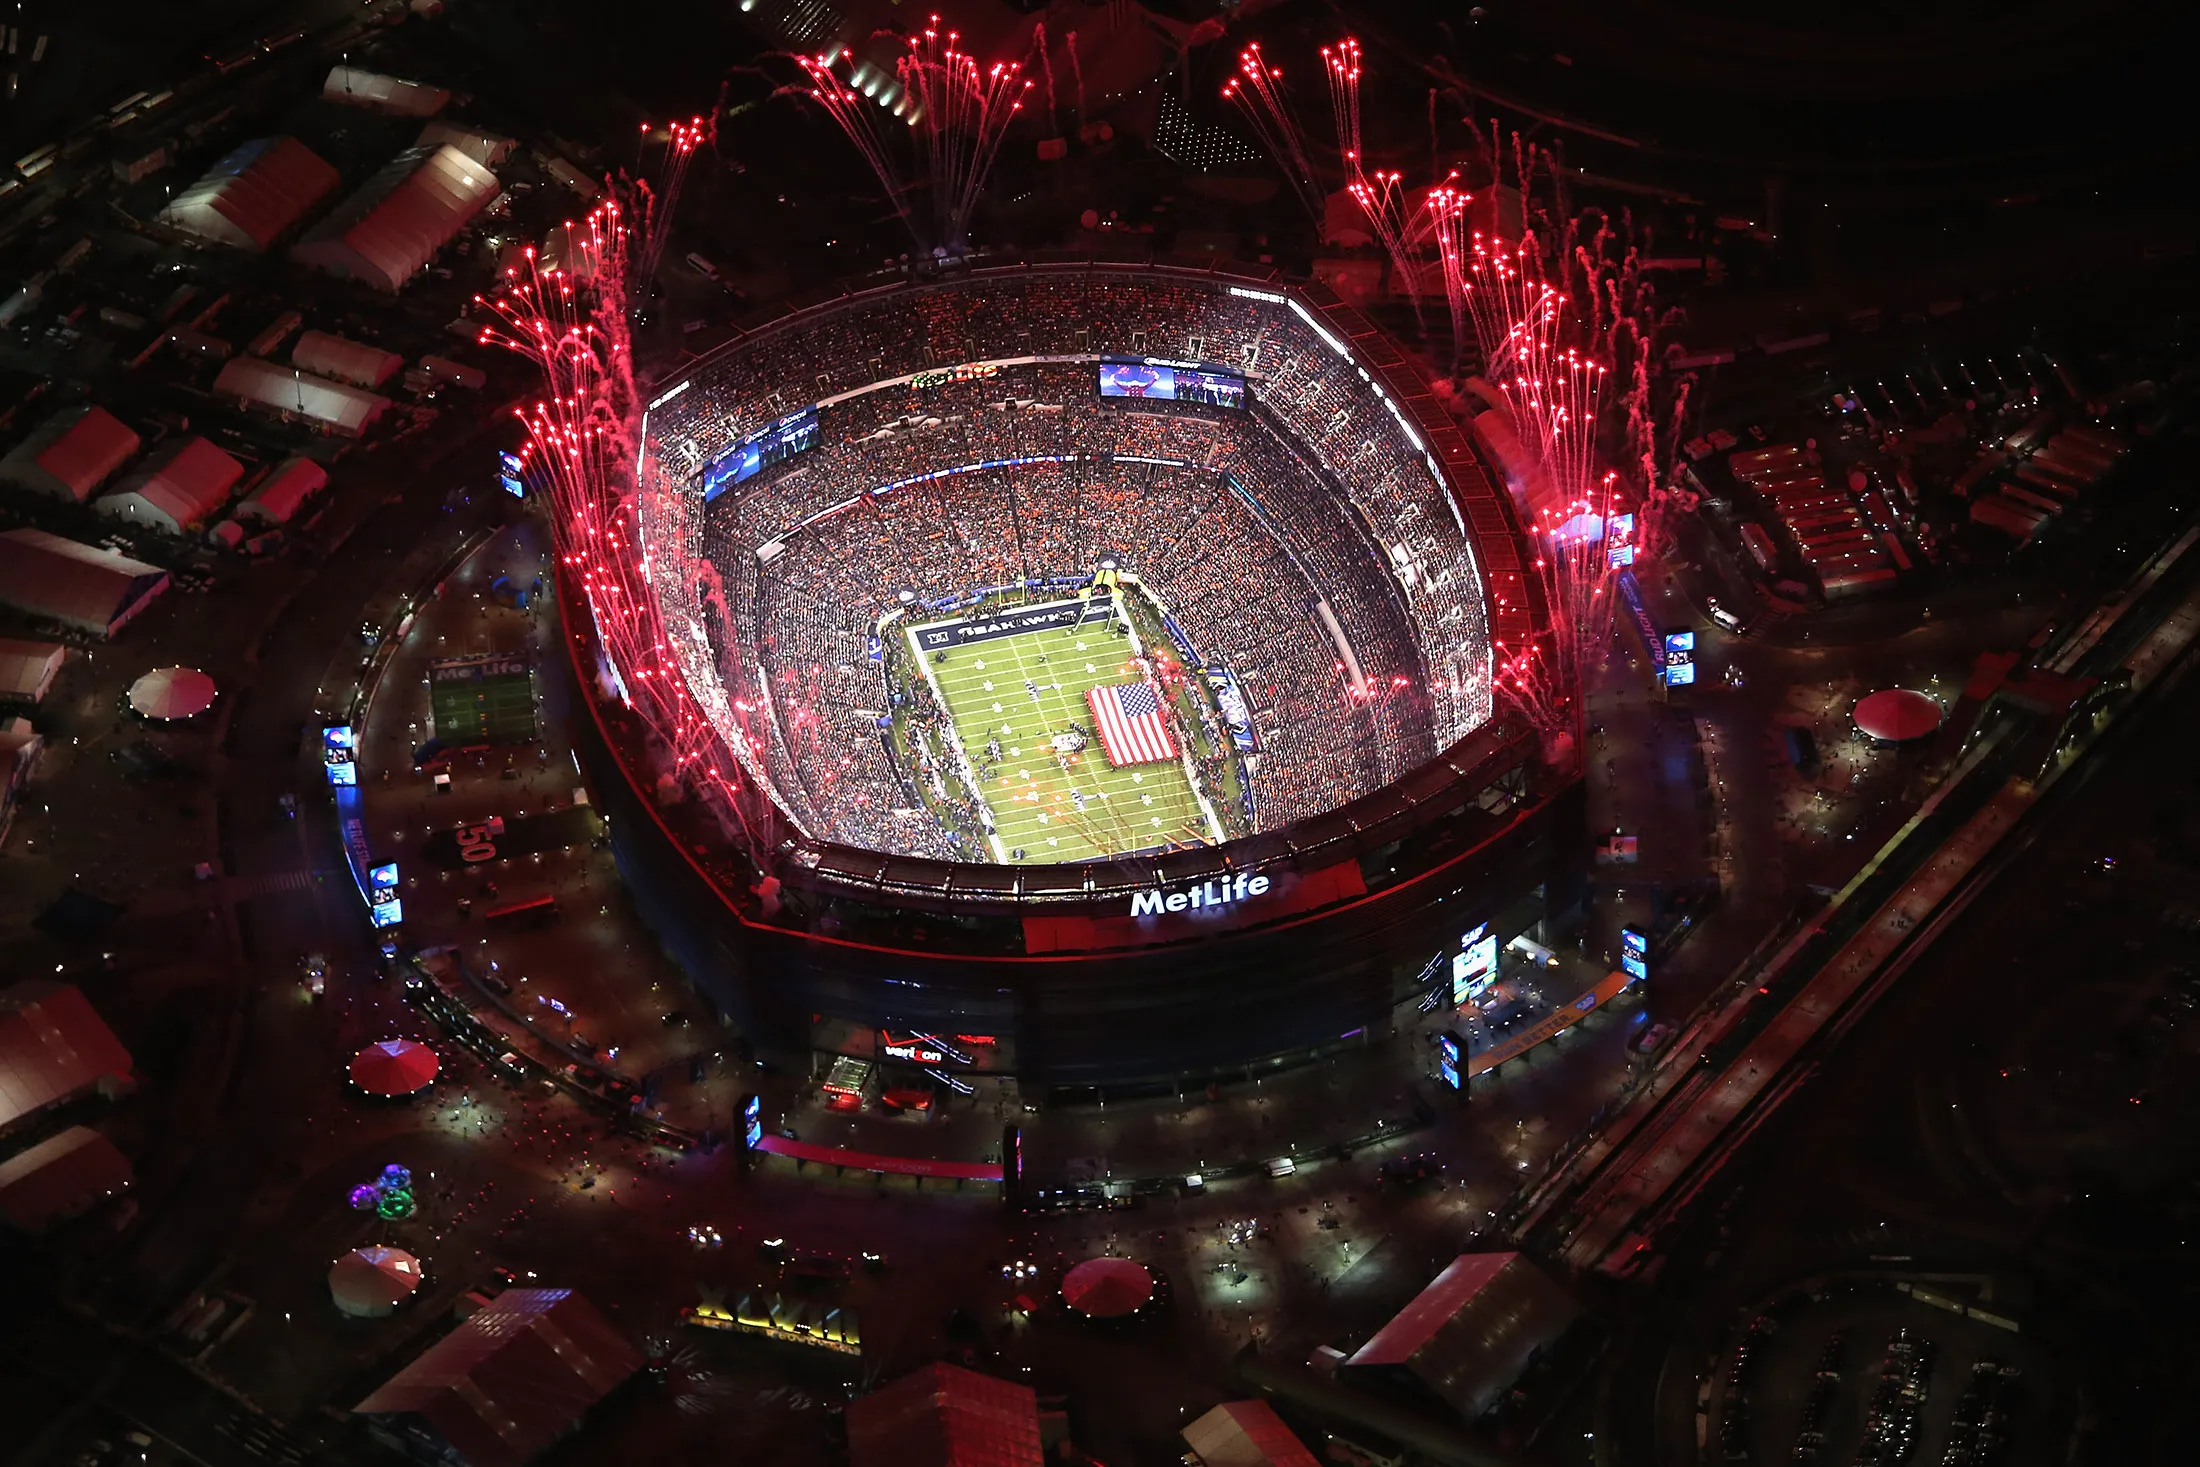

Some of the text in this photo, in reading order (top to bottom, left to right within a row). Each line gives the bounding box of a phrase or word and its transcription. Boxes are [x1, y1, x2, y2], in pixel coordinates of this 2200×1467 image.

[785, 409, 807, 424] pepsi
[749, 426, 770, 442] pepsi
[719, 444, 736, 461] pepsi
[436, 661, 523, 681] MeLife
[455, 824, 497, 863] 50
[1130, 872, 1270, 918] MetLife
[1461, 926, 1484, 948] SAP
[885, 1045, 942, 1063] verizon
